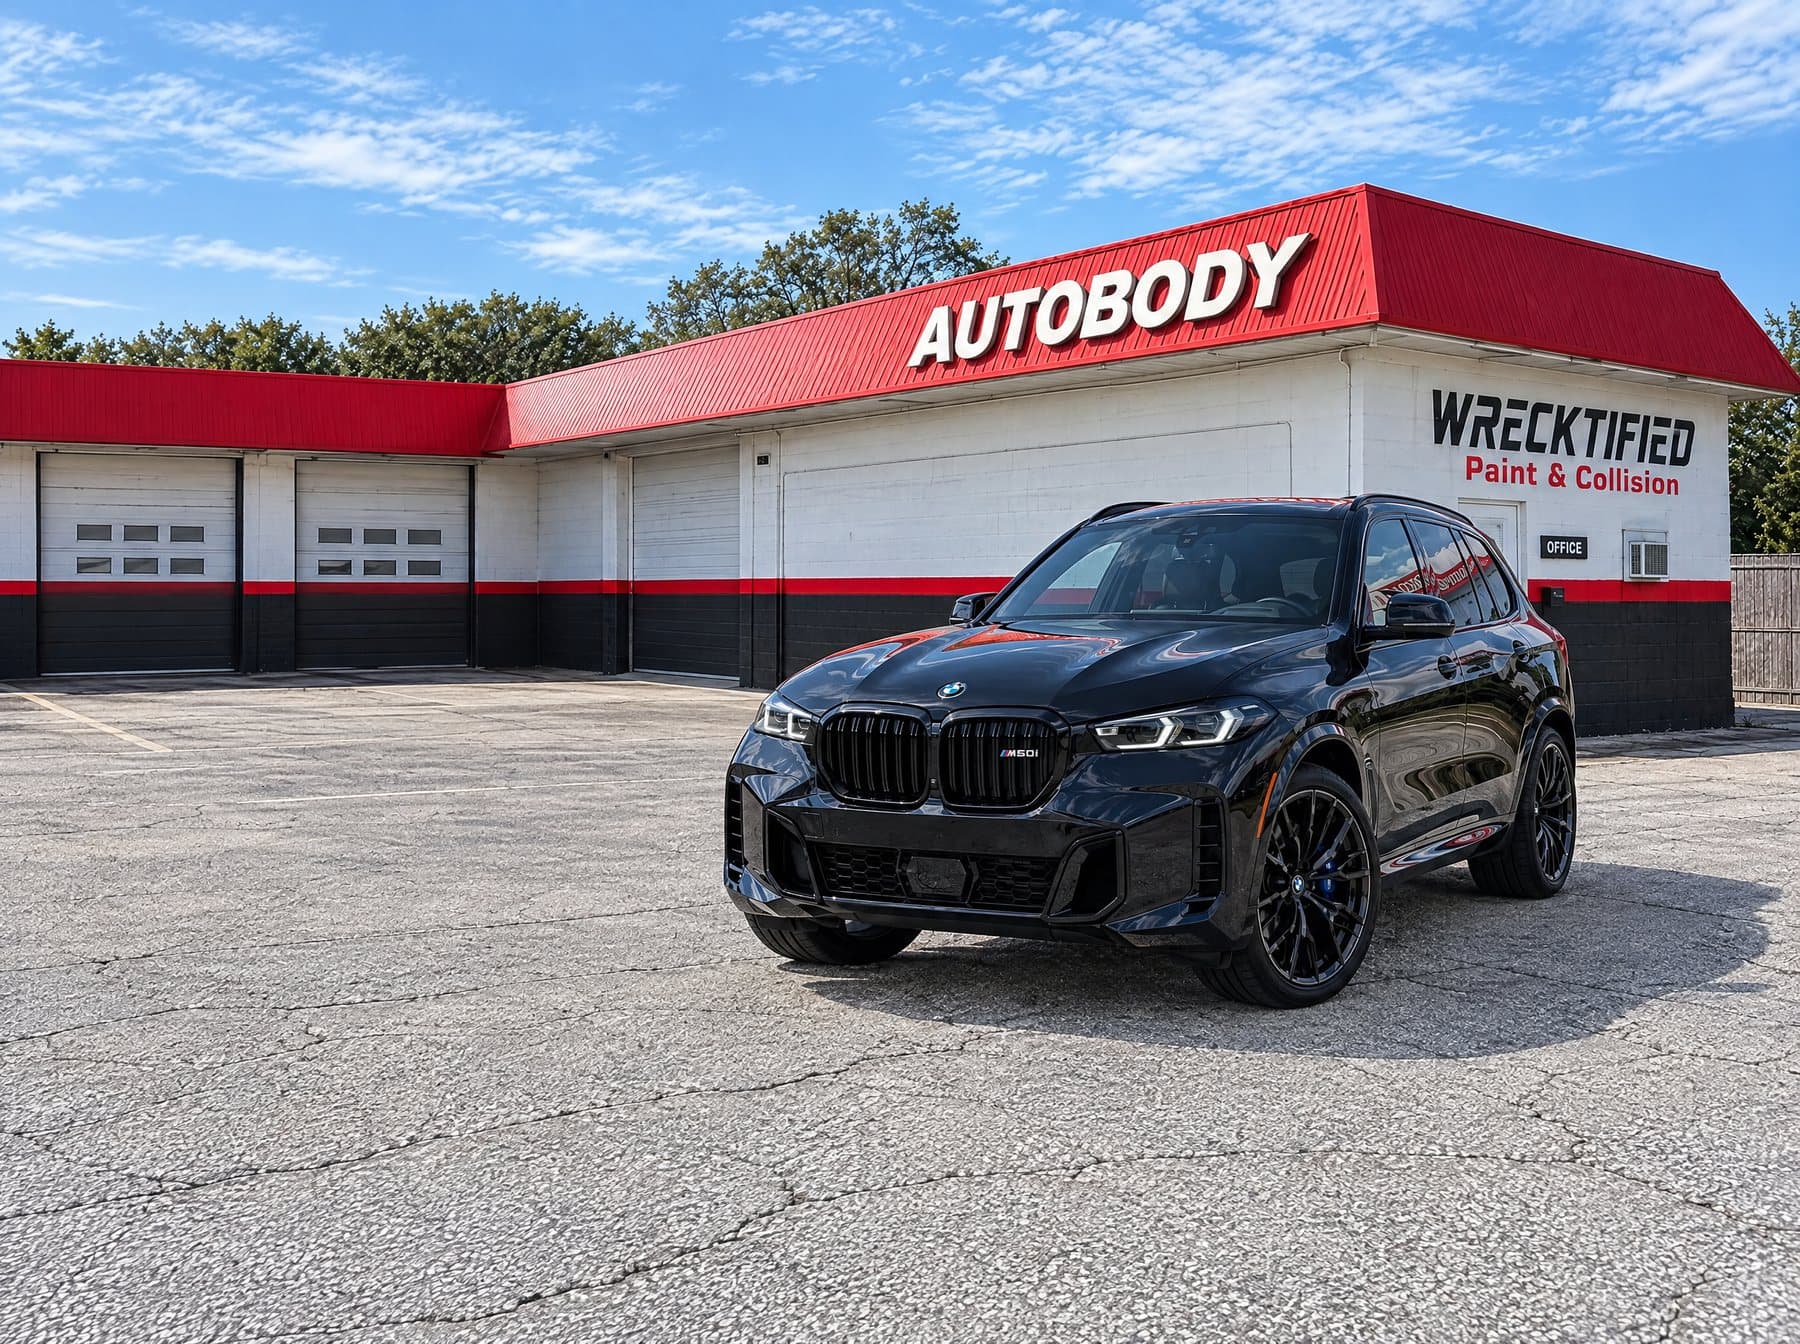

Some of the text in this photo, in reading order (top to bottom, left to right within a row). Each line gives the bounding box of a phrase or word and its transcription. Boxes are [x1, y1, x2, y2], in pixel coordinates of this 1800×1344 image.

[907, 232, 1312, 369] AUTOBODY
[1432, 388, 1696, 467] WRECKTIFIED
[1465, 455, 1679, 495] Paint & Collision
[1547, 540, 1583, 554] OFFICE
